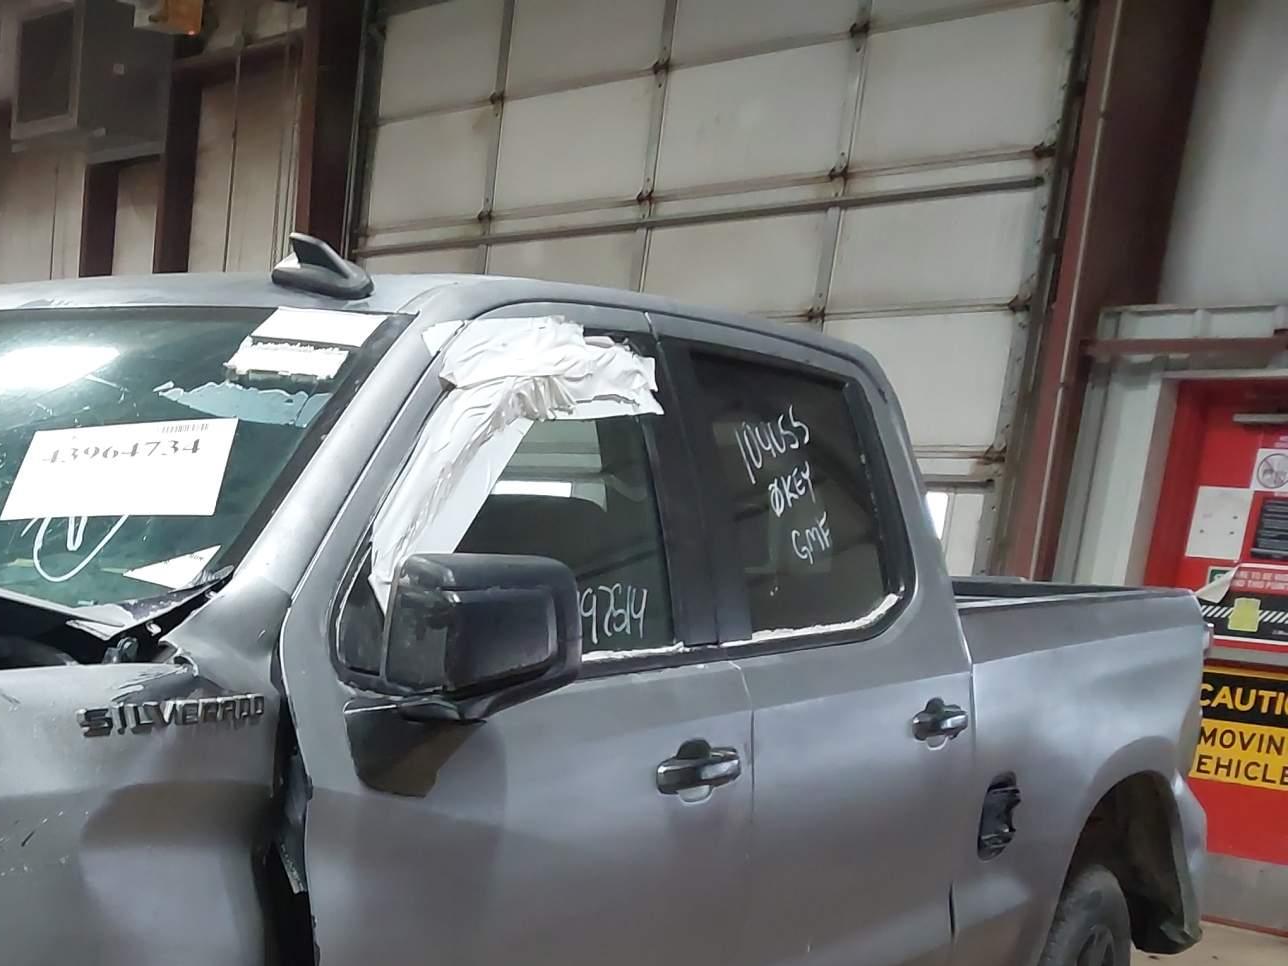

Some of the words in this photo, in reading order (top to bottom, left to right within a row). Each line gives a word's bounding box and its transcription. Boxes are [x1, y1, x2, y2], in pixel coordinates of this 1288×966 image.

[42, 439, 201, 463] 43964734
[74, 693, 265, 737] SILVERADO
[1199, 683, 1288, 715] CAUTI
